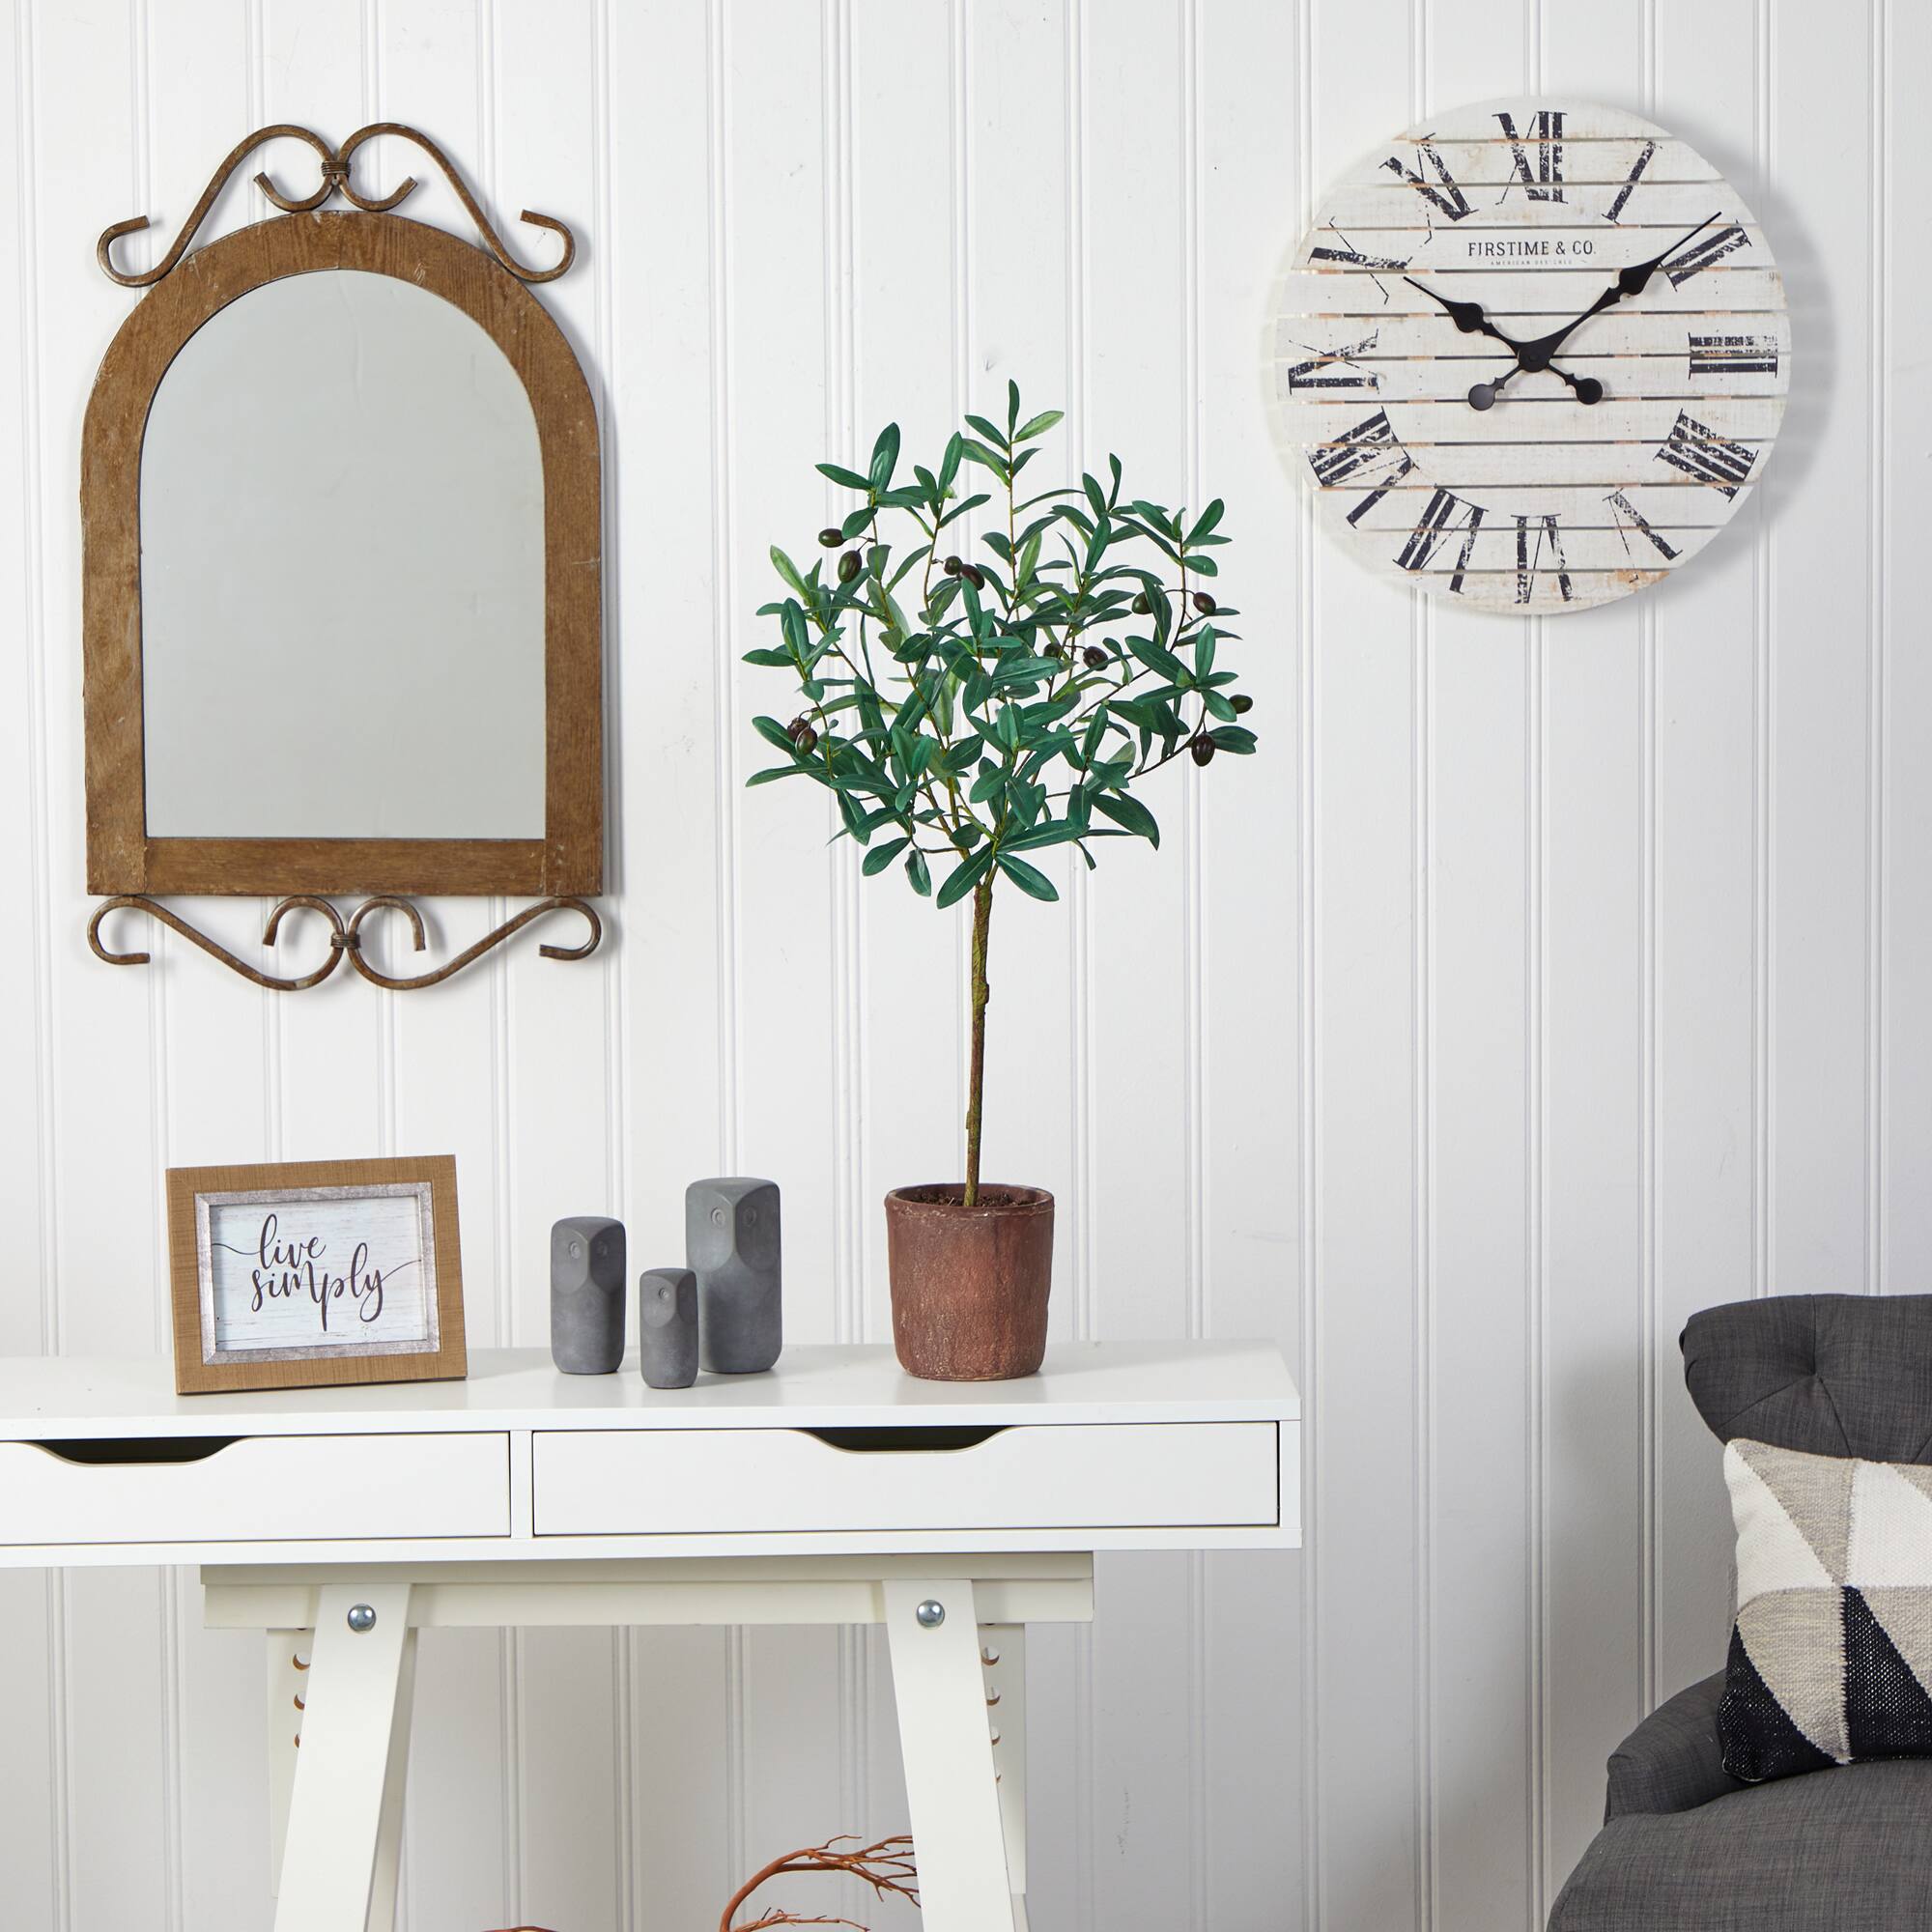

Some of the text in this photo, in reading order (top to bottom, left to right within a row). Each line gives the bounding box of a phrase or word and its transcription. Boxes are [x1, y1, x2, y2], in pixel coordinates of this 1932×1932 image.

[1492, 111, 1569, 204] XII
[1468, 240, 1597, 256] FIRSTIME & CO.
[1511, 513, 1587, 605] VI
[211, 1213, 327, 1269] live
[251, 1242, 422, 1332] simply
